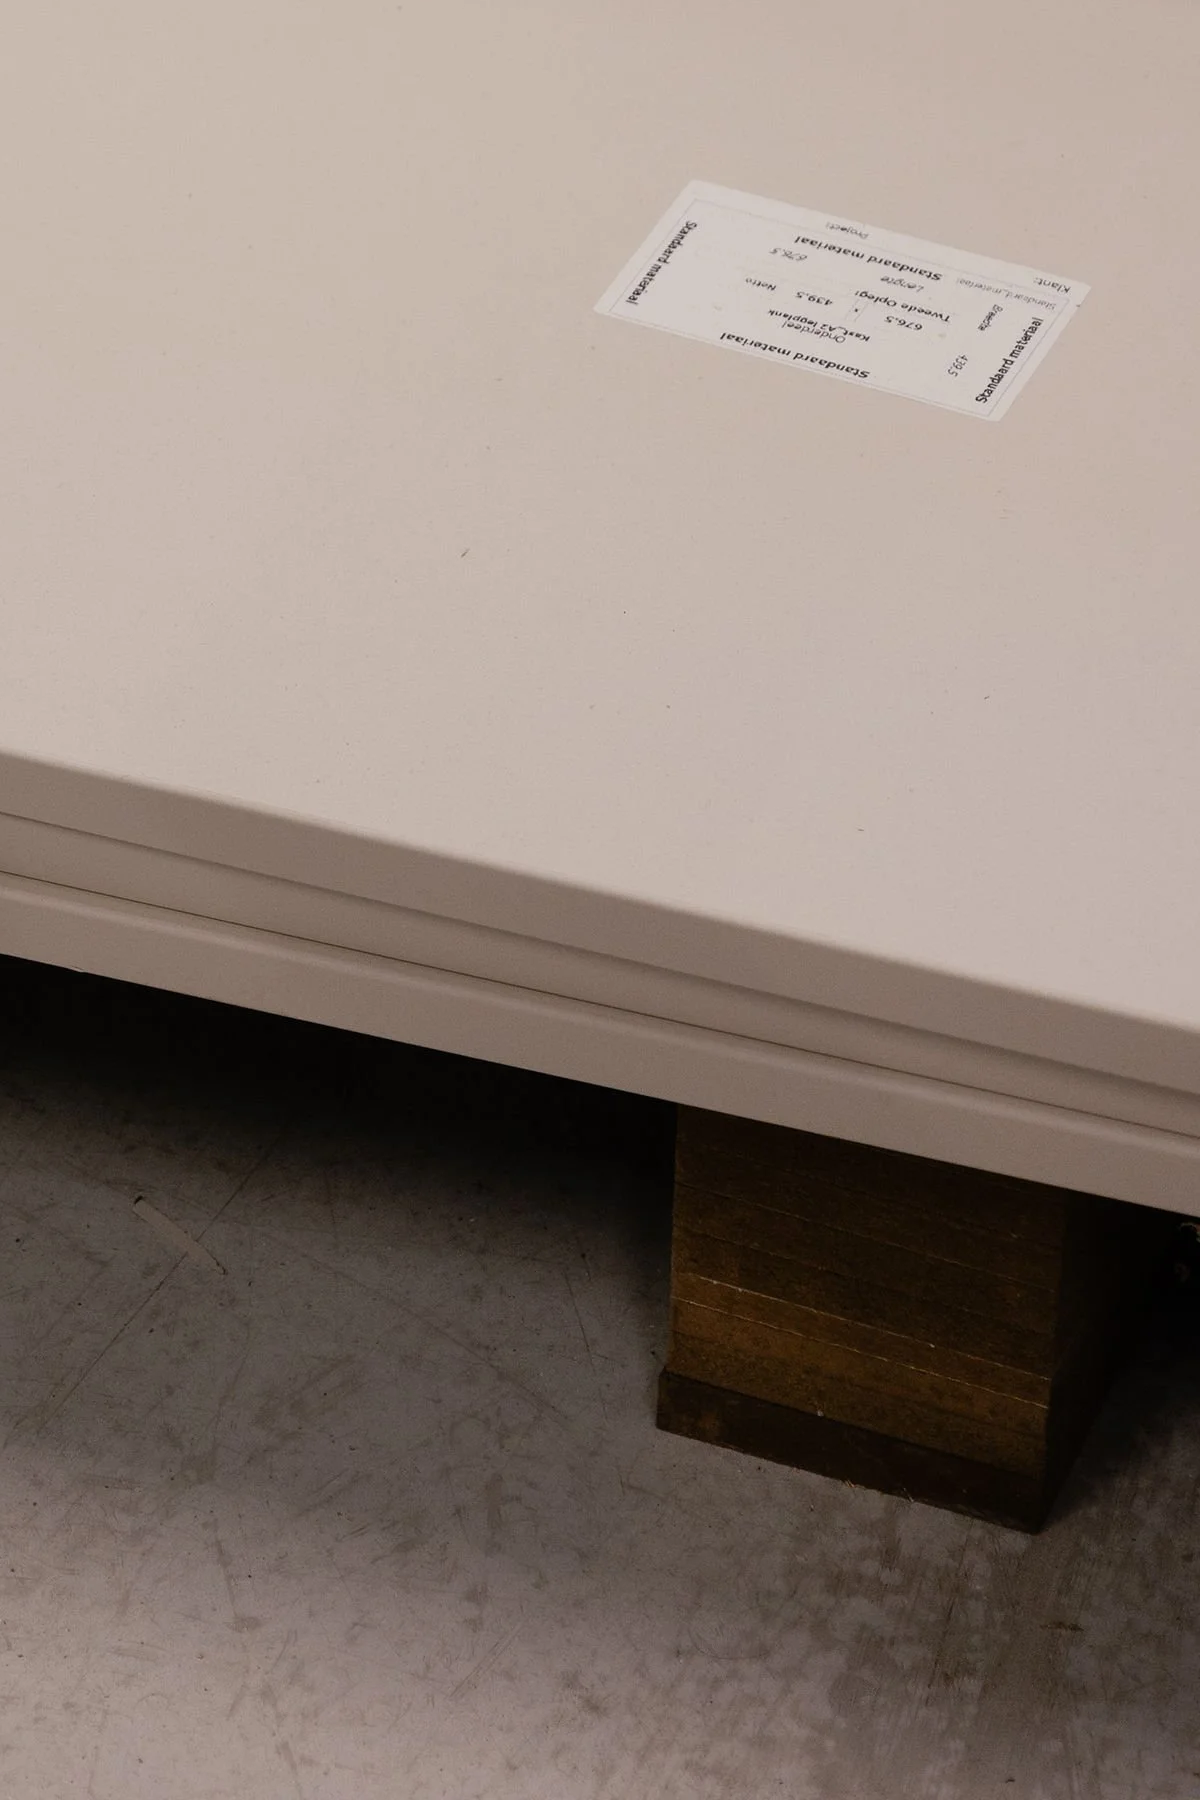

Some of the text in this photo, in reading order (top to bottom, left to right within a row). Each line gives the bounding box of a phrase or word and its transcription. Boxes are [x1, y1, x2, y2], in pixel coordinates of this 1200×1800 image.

[626, 221, 697, 305] Standaard materiaal
[794, 236, 942, 280] Standaard materiaal
[1034, 278, 1071, 293] Klant:
[796, 292, 832, 305] 439.5
[885, 316, 922, 330] 676.5
[901, 304, 950, 322] Tweede
[782, 321, 846, 343] Onderdeel
[720, 333, 870, 378] Standaard materiaal
[975, 317, 1043, 403] Standaard materiaal
